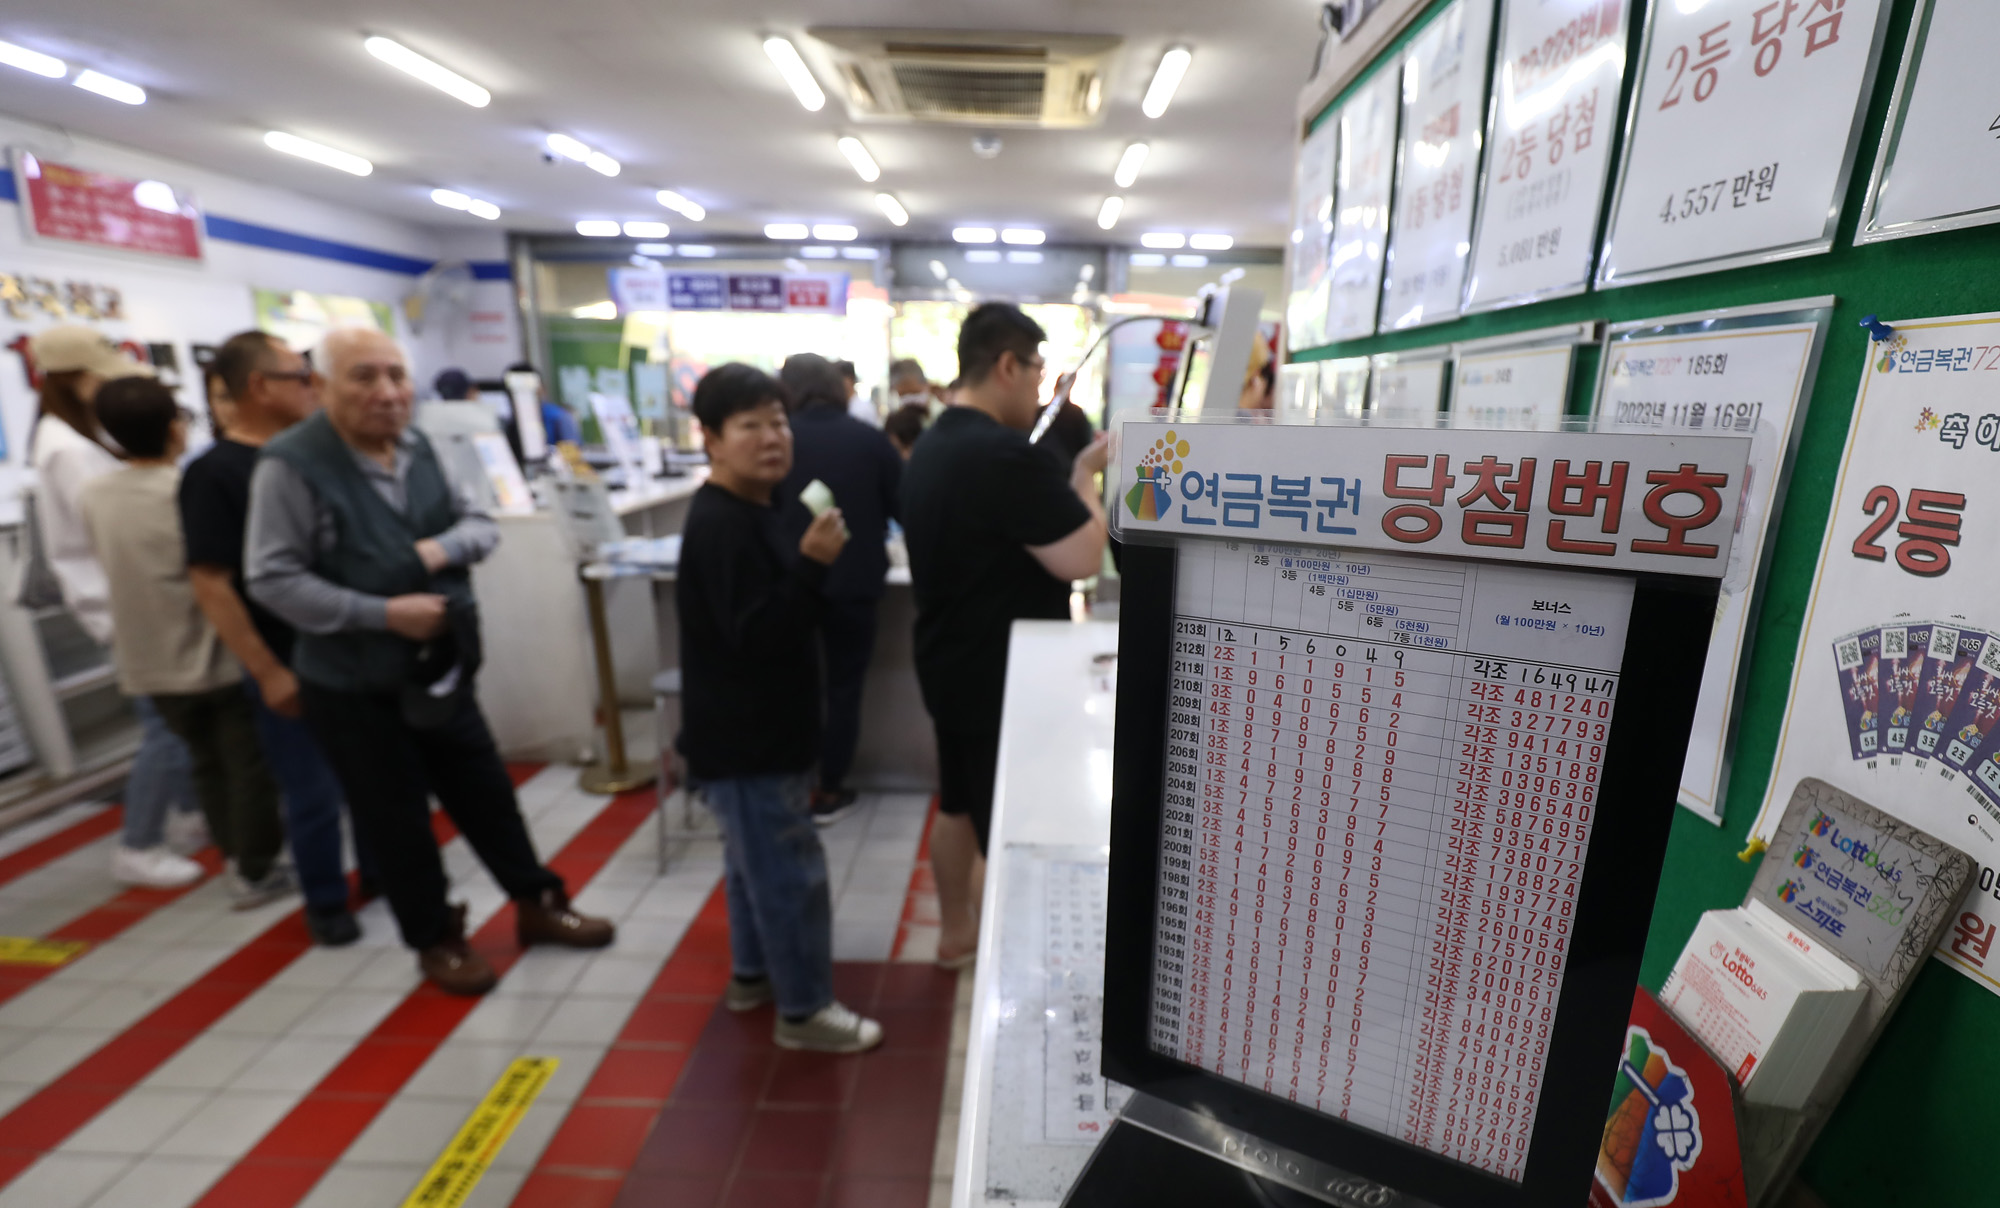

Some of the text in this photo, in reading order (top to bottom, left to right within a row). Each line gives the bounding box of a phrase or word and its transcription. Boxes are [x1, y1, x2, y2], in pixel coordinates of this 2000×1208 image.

[1658, 20, 1732, 111] 2등
[1498, 87, 1599, 184] 2등 당첨
[1731, 162, 1779, 208] 만원
[1687, 353, 1728, 376] 185회
[1672, 402, 1707, 430] 11월
[1713, 402, 1763, 434] 16일]
[1179, 453, 1730, 559] 연금복권 당첨번호
[1852, 485, 1966, 578] 2등
[1254, 555, 1270, 566] 2등
[1281, 569, 1349, 586] 3등 (1백만원)
[1309, 585, 1379, 601] 4등 (1십만원)
[1337, 600, 1399, 616] 5등 (5만원)
[1531, 599, 1572, 615] 보너스
[1366, 616, 1430, 633] 6등 (5천원)
[1393, 631, 1449, 648] 7등 (1천원)
[1513, 617, 1556, 631] 100만원
[1575, 623, 1605, 637] 10년)
[1176, 622, 1207, 638] 213회
[1473, 659, 1508, 680] 각조
[1175, 641, 1205, 657] 212회
[1213, 645, 1235, 662] 2조
[1471, 681, 1505, 702] 각조
[1174, 660, 1204, 676] 211회
[1214, 666, 1233, 681] 1조
[1467, 703, 1502, 724] 각조
[1174, 678, 1203, 695] 210회
[1211, 683, 1232, 700] 3조
[1464, 724, 1499, 745] 각조
[1172, 712, 1201, 728] 208회
[1211, 718, 1230, 734] 1조
[1458, 762, 1493, 783] 각조
[1173, 695, 1202, 712] 209회
[1210, 700, 1231, 717] 4조
[1461, 743, 1496, 764] 각조
[1171, 728, 1200, 745] 207회
[1207, 734, 1228, 750] 3조
[1456, 780, 1489, 802] 각조
[1952, 746, 1966, 762] 2조
[1984, 765, 1999, 782] 1조
[1169, 761, 1198, 778] 205회
[1207, 768, 1225, 784] 1조
[1451, 817, 1484, 839] 각조
[1170, 745, 1199, 761] 206회
[1207, 751, 1227, 767] 3조
[1453, 799, 1486, 821] 각조
[1167, 793, 1195, 810] 203회
[1203, 799, 1223, 816] 3조
[1445, 854, 1478, 875] 각조
[1168, 777, 1196, 794] 204회
[1204, 783, 1224, 800] 5조
[1448, 836, 1481, 857] 각조
[1164, 840, 1192, 857] 200회
[1164, 856, 1191, 872] 199회
[1165, 825, 1193, 841] 201회
[1202, 832, 1221, 848] 1조
[1440, 889, 1473, 911] 각조
[1166, 809, 1194, 825] 202회
[1202, 816, 1222, 832] 2조
[1443, 871, 1475, 893] 각조
[1162, 886, 1189, 902] 197회
[1163, 871, 1190, 887] 198회
[1161, 901, 1188, 917] 196회
[1161, 916, 1187, 932] 195회
[1795, 899, 1847, 938] 스피또
[1160, 931, 1186, 946] 194회
[1951, 911, 1997, 968] 원
